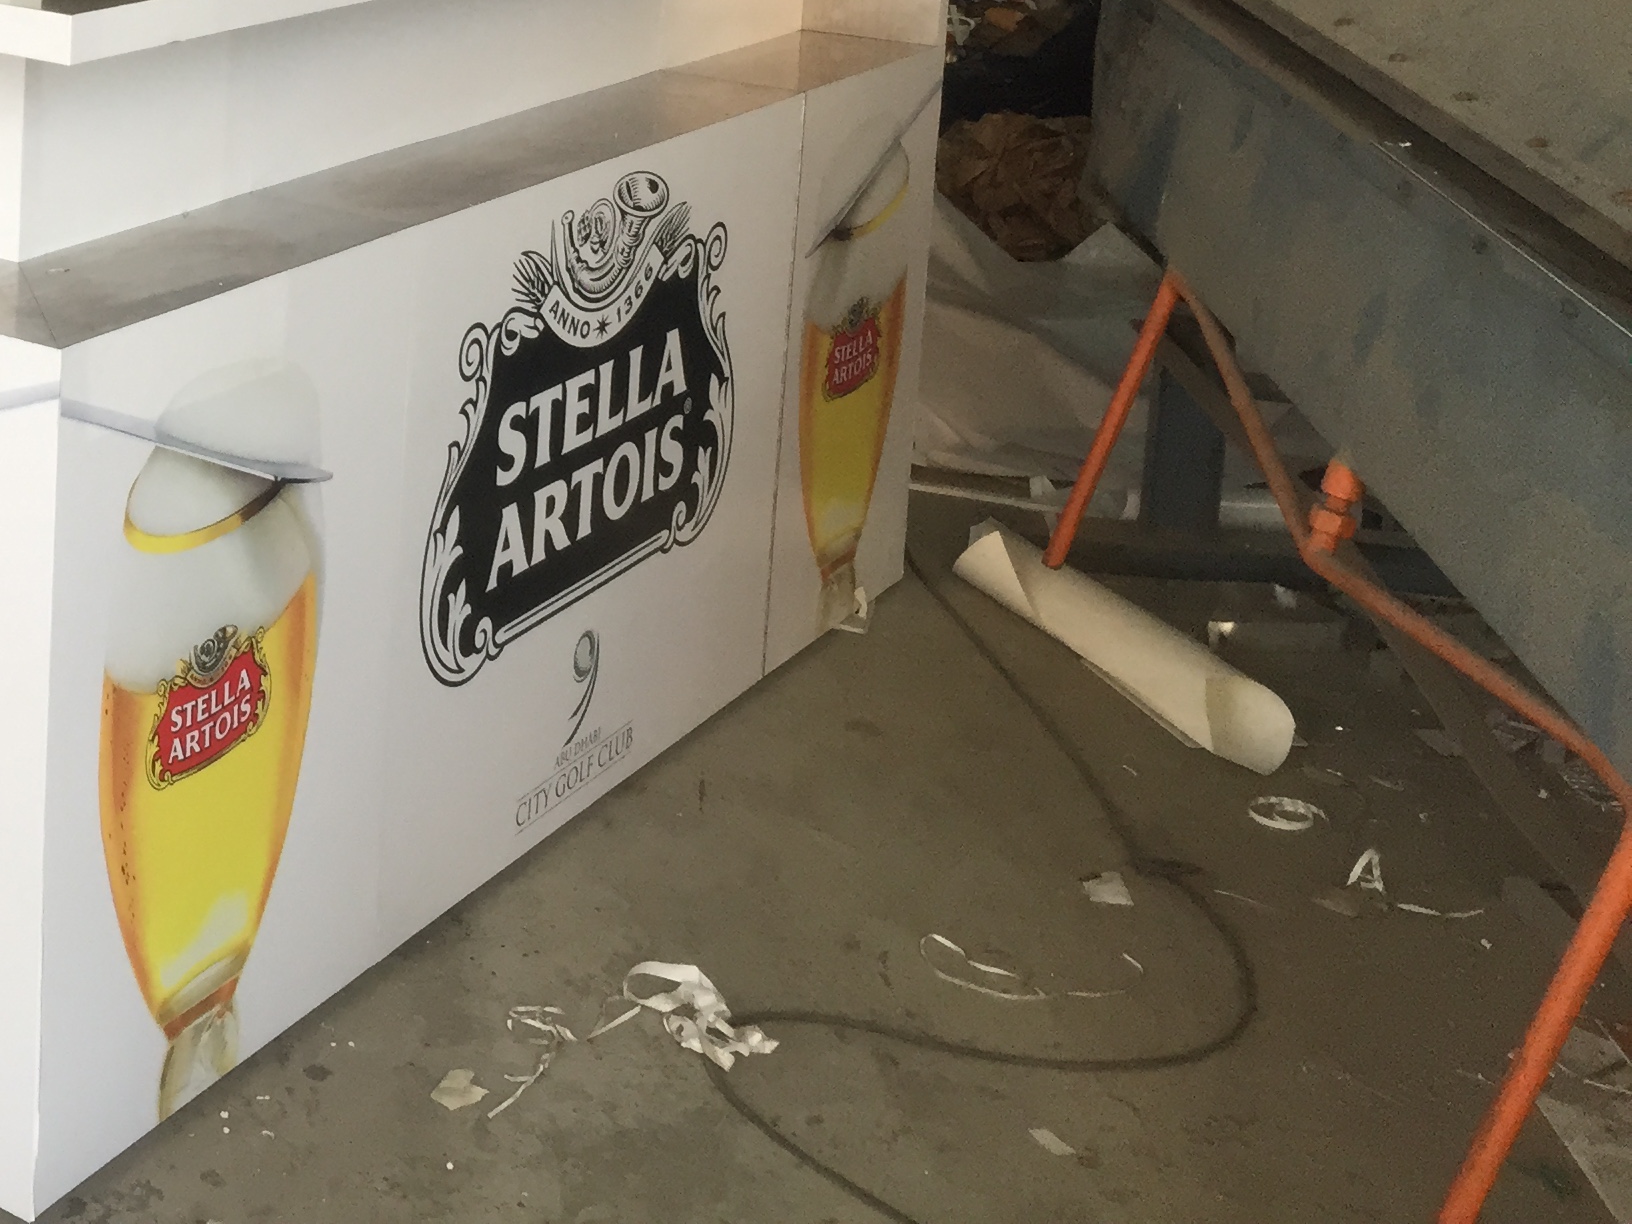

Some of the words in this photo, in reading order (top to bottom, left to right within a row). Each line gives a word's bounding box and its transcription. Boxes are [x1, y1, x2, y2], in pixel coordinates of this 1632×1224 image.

[548, 298, 591, 339] ANNO
[615, 264, 654, 324] 1366
[832, 349, 872, 385] ARTOIS
[834, 329, 873, 364] STELLA
[496, 327, 688, 487] STELLA
[484, 413, 685, 593] ARTOIS
[168, 693, 251, 764] ARTOIS
[170, 668, 251, 733] STELLA
[515, 782, 553, 827] CITY
[555, 753, 594, 798] GOLF
[597, 726, 634, 768] CLUB
